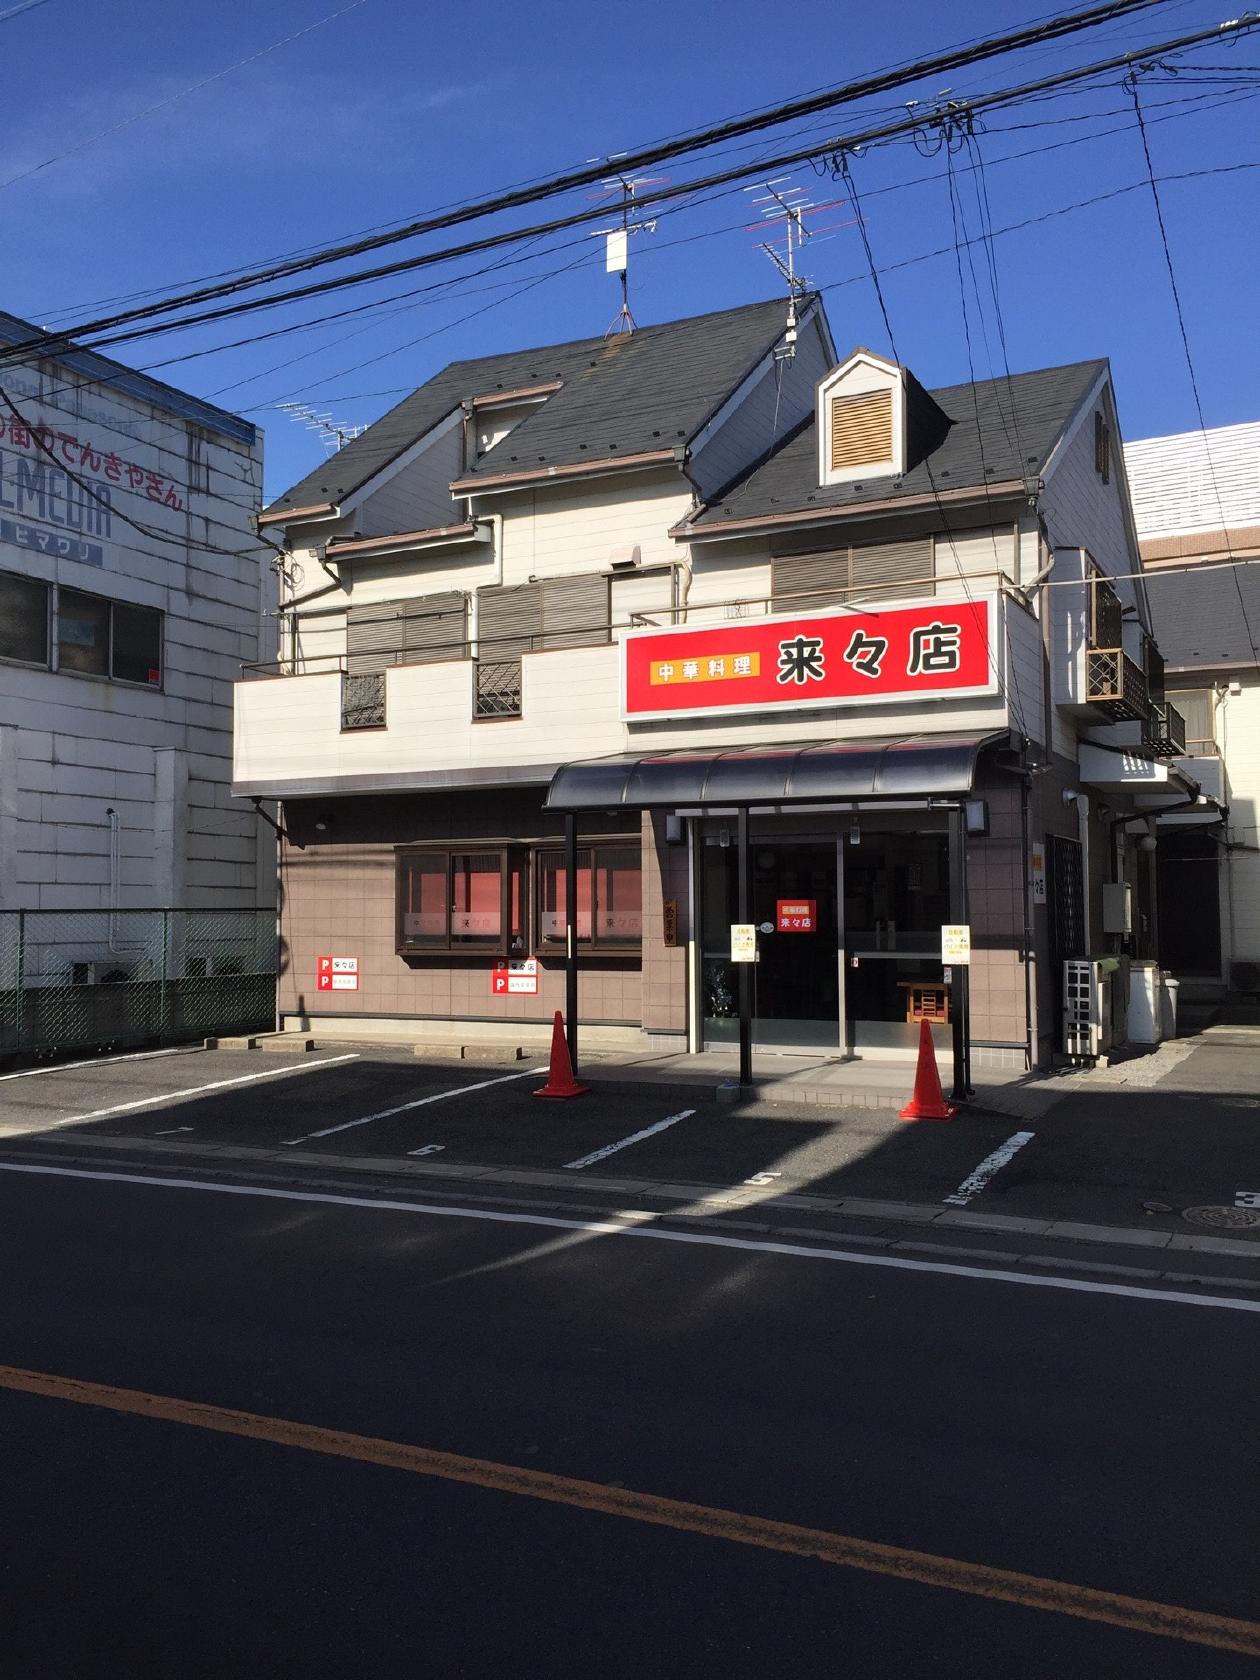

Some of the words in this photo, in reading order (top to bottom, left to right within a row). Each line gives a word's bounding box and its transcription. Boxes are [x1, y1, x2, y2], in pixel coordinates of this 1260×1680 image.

[0, 412, 183, 512] 街のでんきやさん
[16, 525, 89, 560] ヒマワリ
[777, 622, 960, 684] 来々店
[658, 655, 751, 682] 中華料理
[780, 917, 812, 928] 来々店
[321, 959, 330, 971] P
[496, 961, 505, 973] P
[321, 975, 329, 988] P
[496, 978, 505, 991] P
